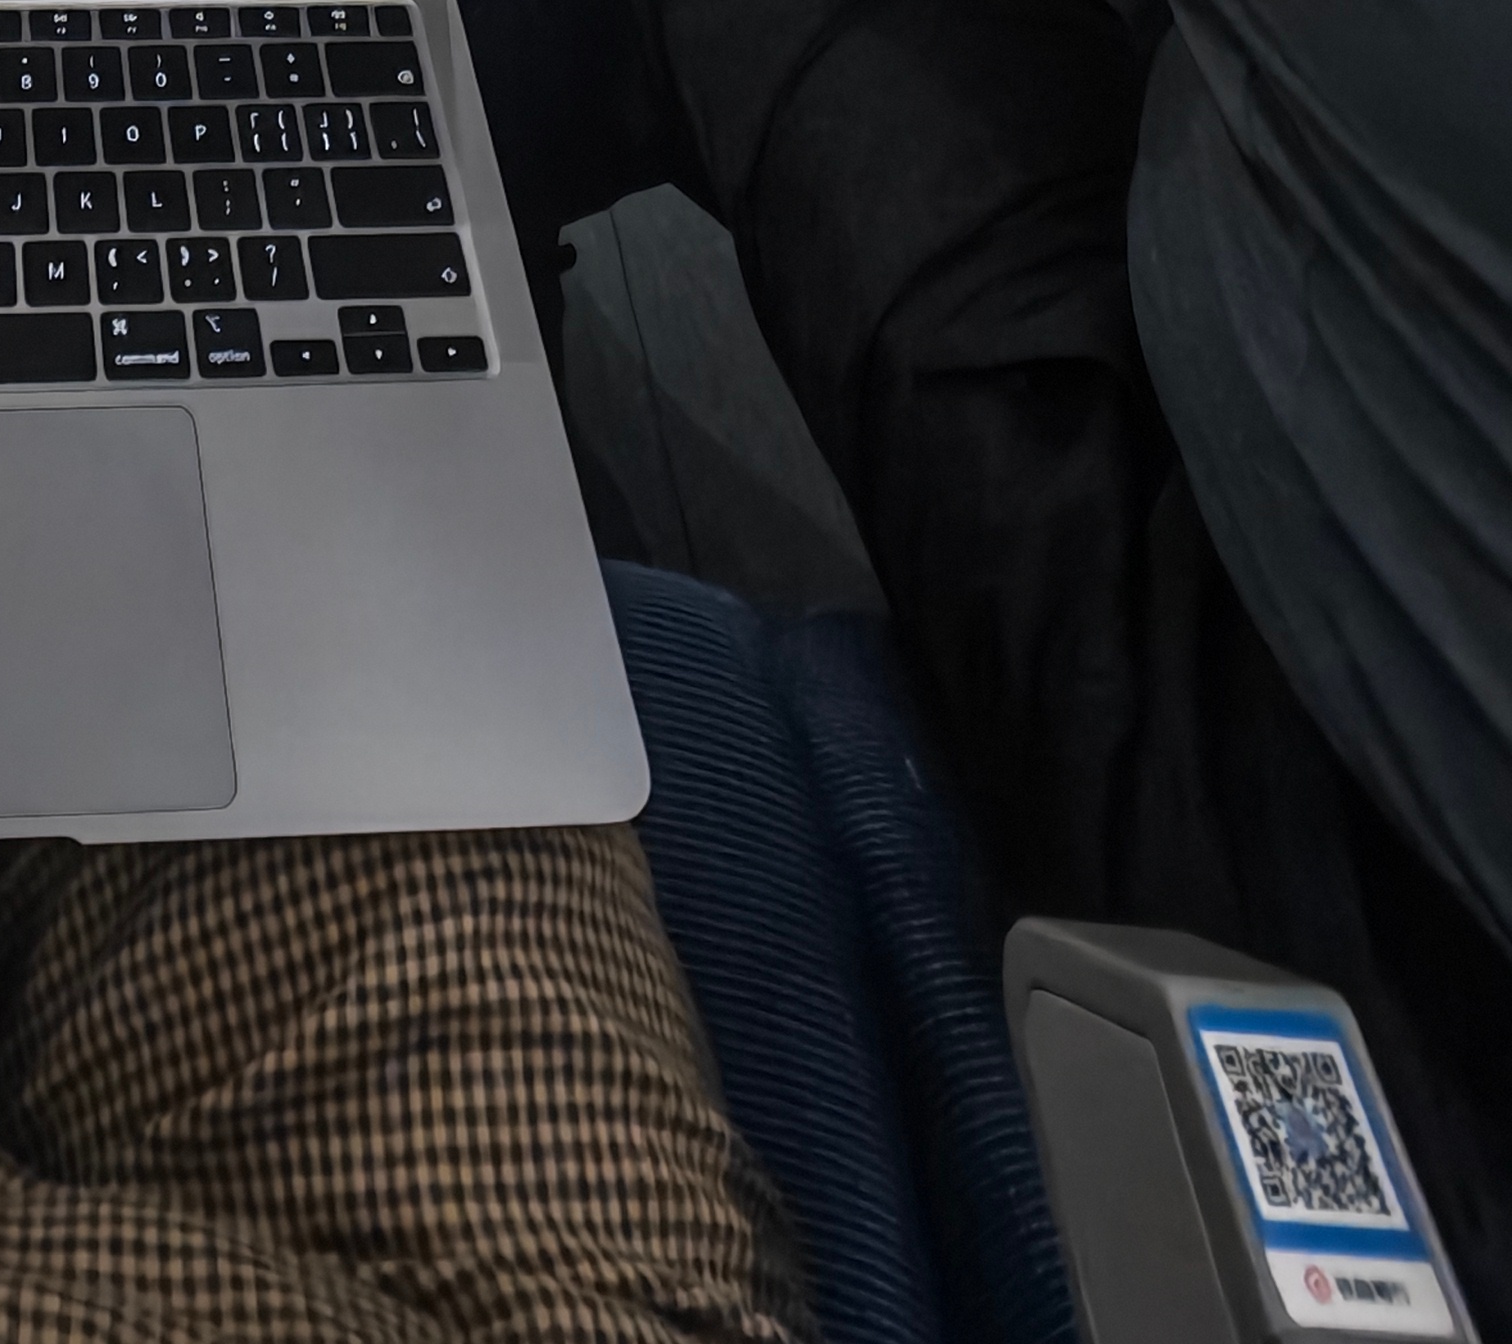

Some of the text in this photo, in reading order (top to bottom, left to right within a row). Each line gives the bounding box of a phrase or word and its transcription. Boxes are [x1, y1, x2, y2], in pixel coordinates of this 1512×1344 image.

[88, 73, 100, 90] 9
[61, 127, 67, 144] I
[126, 125, 140, 142] O
[194, 124, 207, 141] P
[11, 193, 22, 211] J
[80, 192, 93, 209] K
[151, 191, 163, 208] L
[48, 261, 65, 280] M
